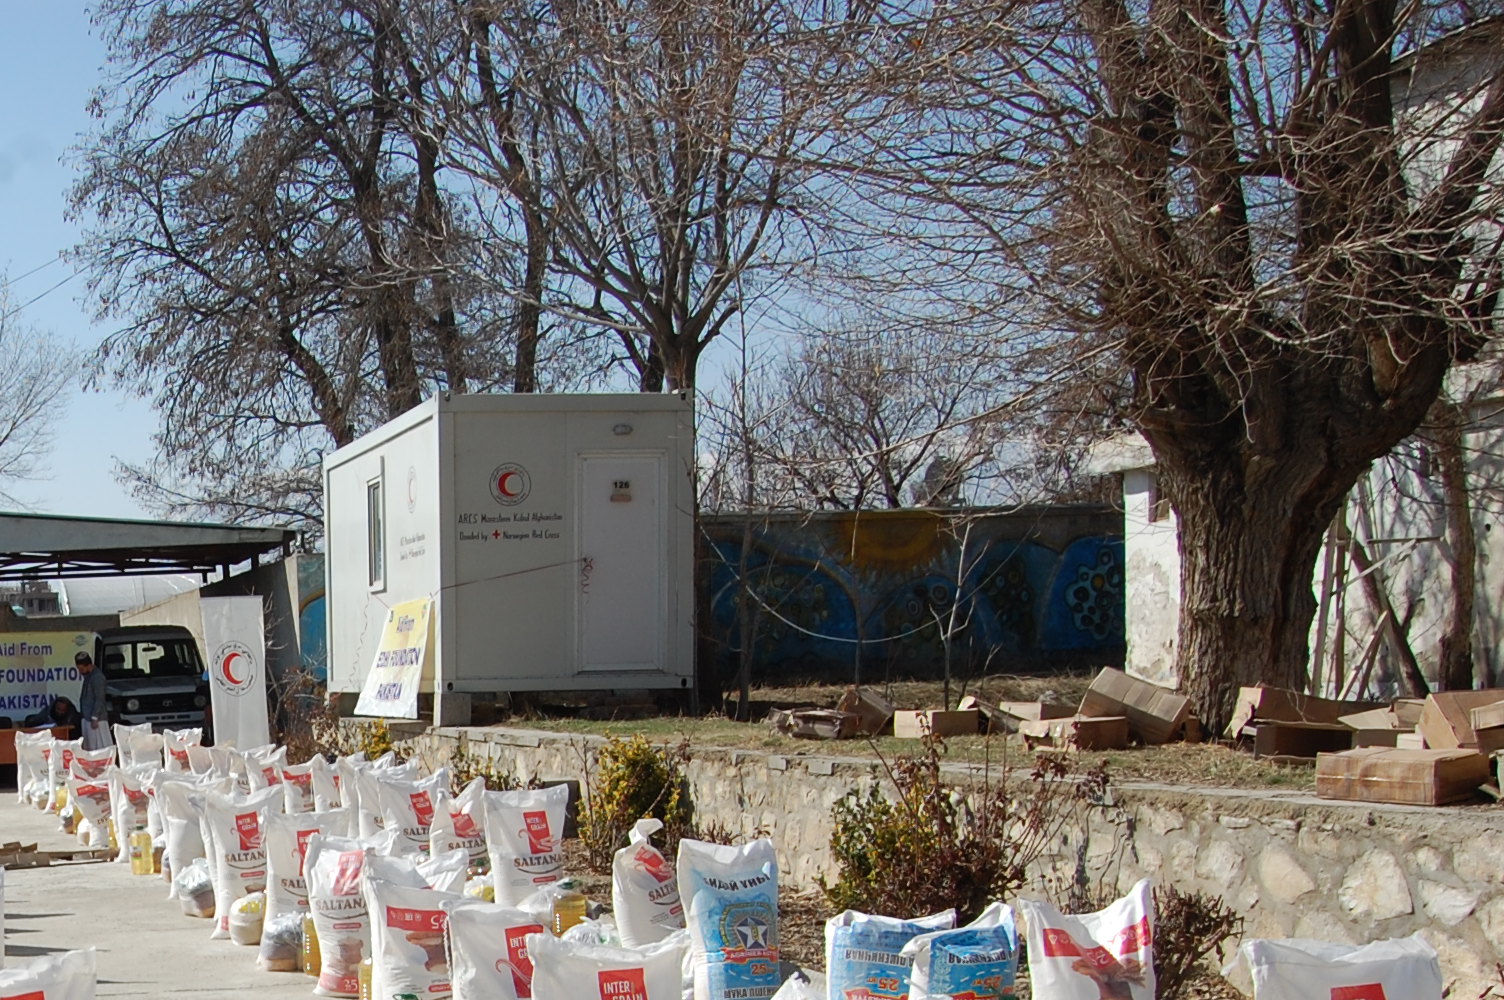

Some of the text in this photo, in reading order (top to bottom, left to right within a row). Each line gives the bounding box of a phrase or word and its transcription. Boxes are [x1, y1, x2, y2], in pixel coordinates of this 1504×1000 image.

[613, 481, 630, 489] 126
[21, 642, 53, 655] From
[225, 851, 266, 863] SALTAN
[603, 981, 632, 994] INTER
[879, 978, 899, 991] 25
